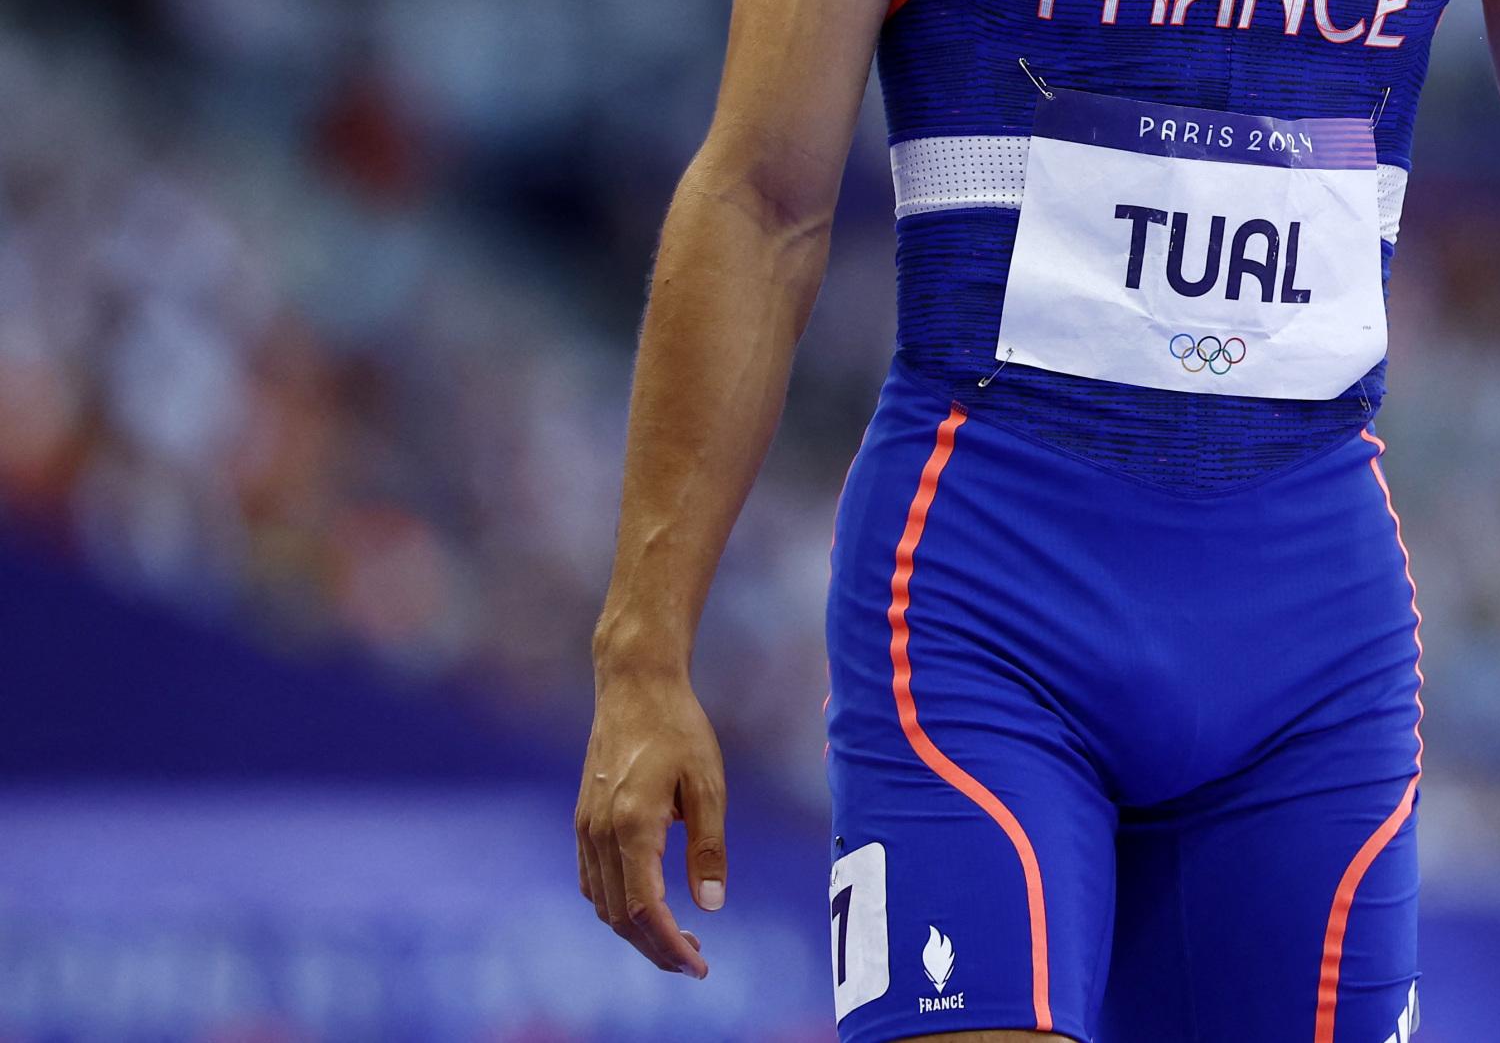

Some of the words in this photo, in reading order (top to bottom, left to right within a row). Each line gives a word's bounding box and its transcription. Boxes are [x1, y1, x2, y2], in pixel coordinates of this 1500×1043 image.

[1247, 129, 1314, 153] 2024
[1113, 203, 1312, 304] TUAL
[918, 992, 965, 1014] FRANCE
